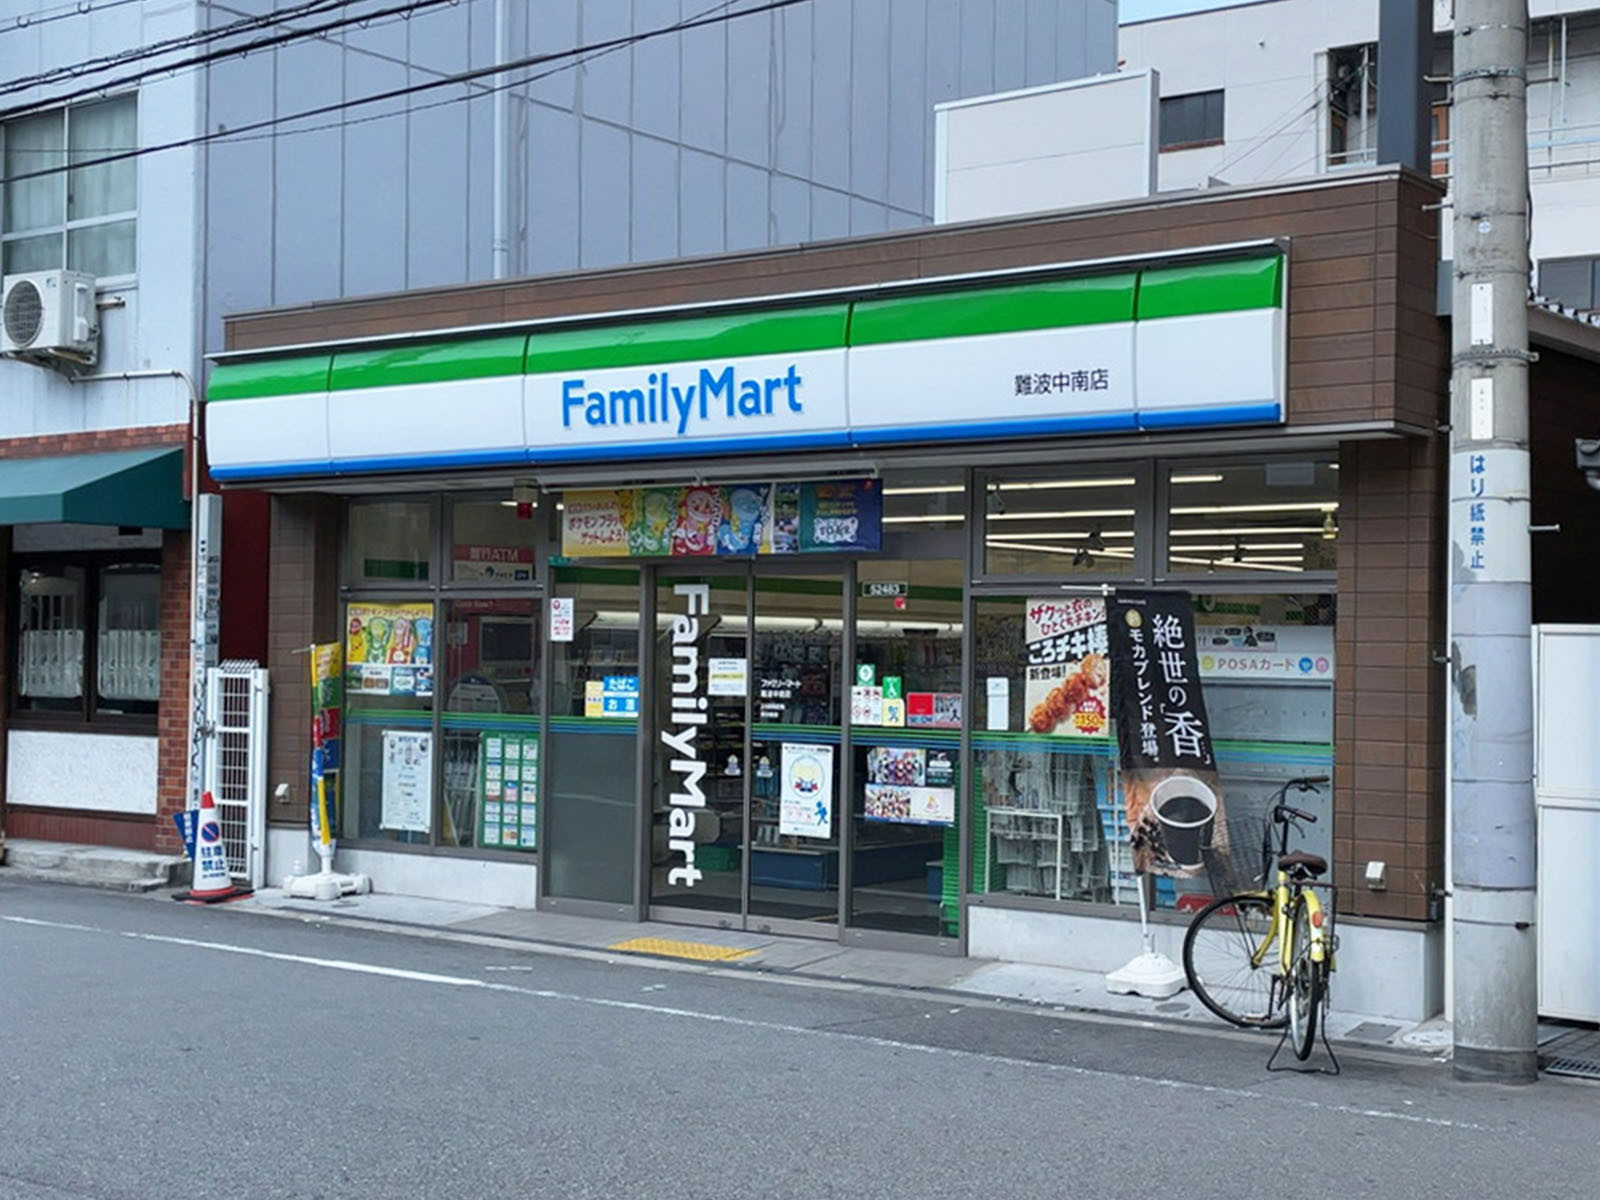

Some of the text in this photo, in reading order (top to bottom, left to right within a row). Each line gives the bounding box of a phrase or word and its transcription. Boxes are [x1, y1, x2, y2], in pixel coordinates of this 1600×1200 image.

[562, 364, 804, 435] FamilyMart
[1014, 368, 1109, 396] 難波中南店
[1469, 454, 1486, 570] はり紙禁止
[1217, 657, 1296, 673] POSAカード
[660, 584, 710, 888] FamilyMart
